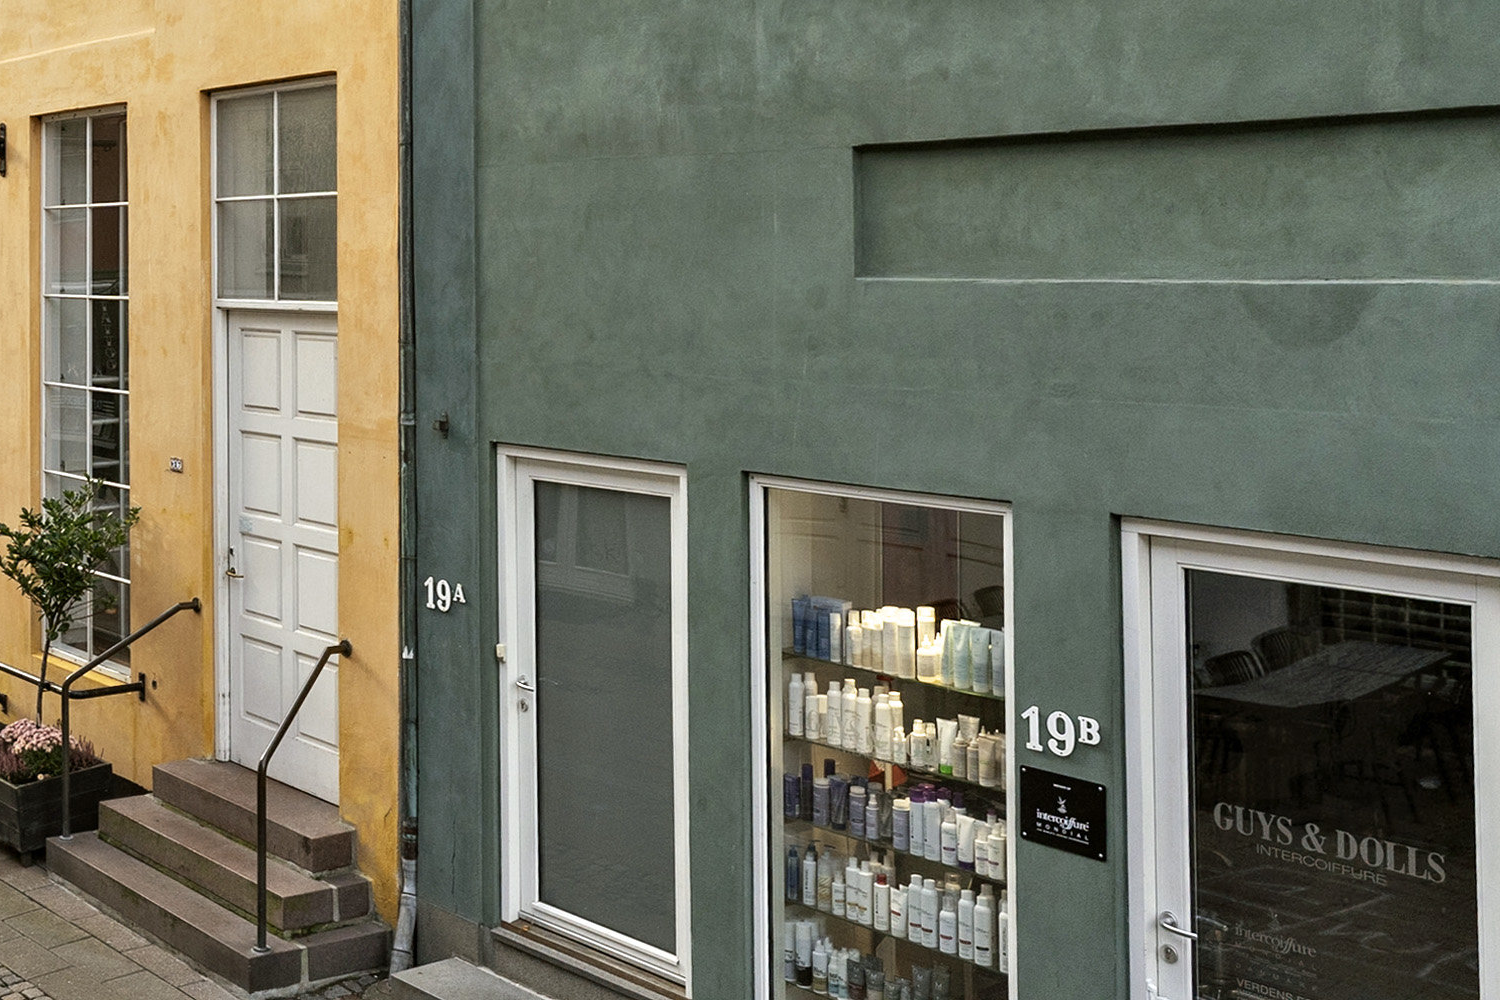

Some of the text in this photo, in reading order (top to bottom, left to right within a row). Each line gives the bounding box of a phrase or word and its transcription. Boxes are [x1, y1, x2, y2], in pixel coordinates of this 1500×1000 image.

[424, 576, 466, 612] 19A
[1020, 705, 1101, 757] 19B
[1036, 822, 1090, 841] MONDIAL
[1213, 802, 1446, 884] GUYS & DOLLS
[1256, 843, 1389, 887] INTERCOIFFURE
[1235, 922, 1318, 958] intercoiffure
